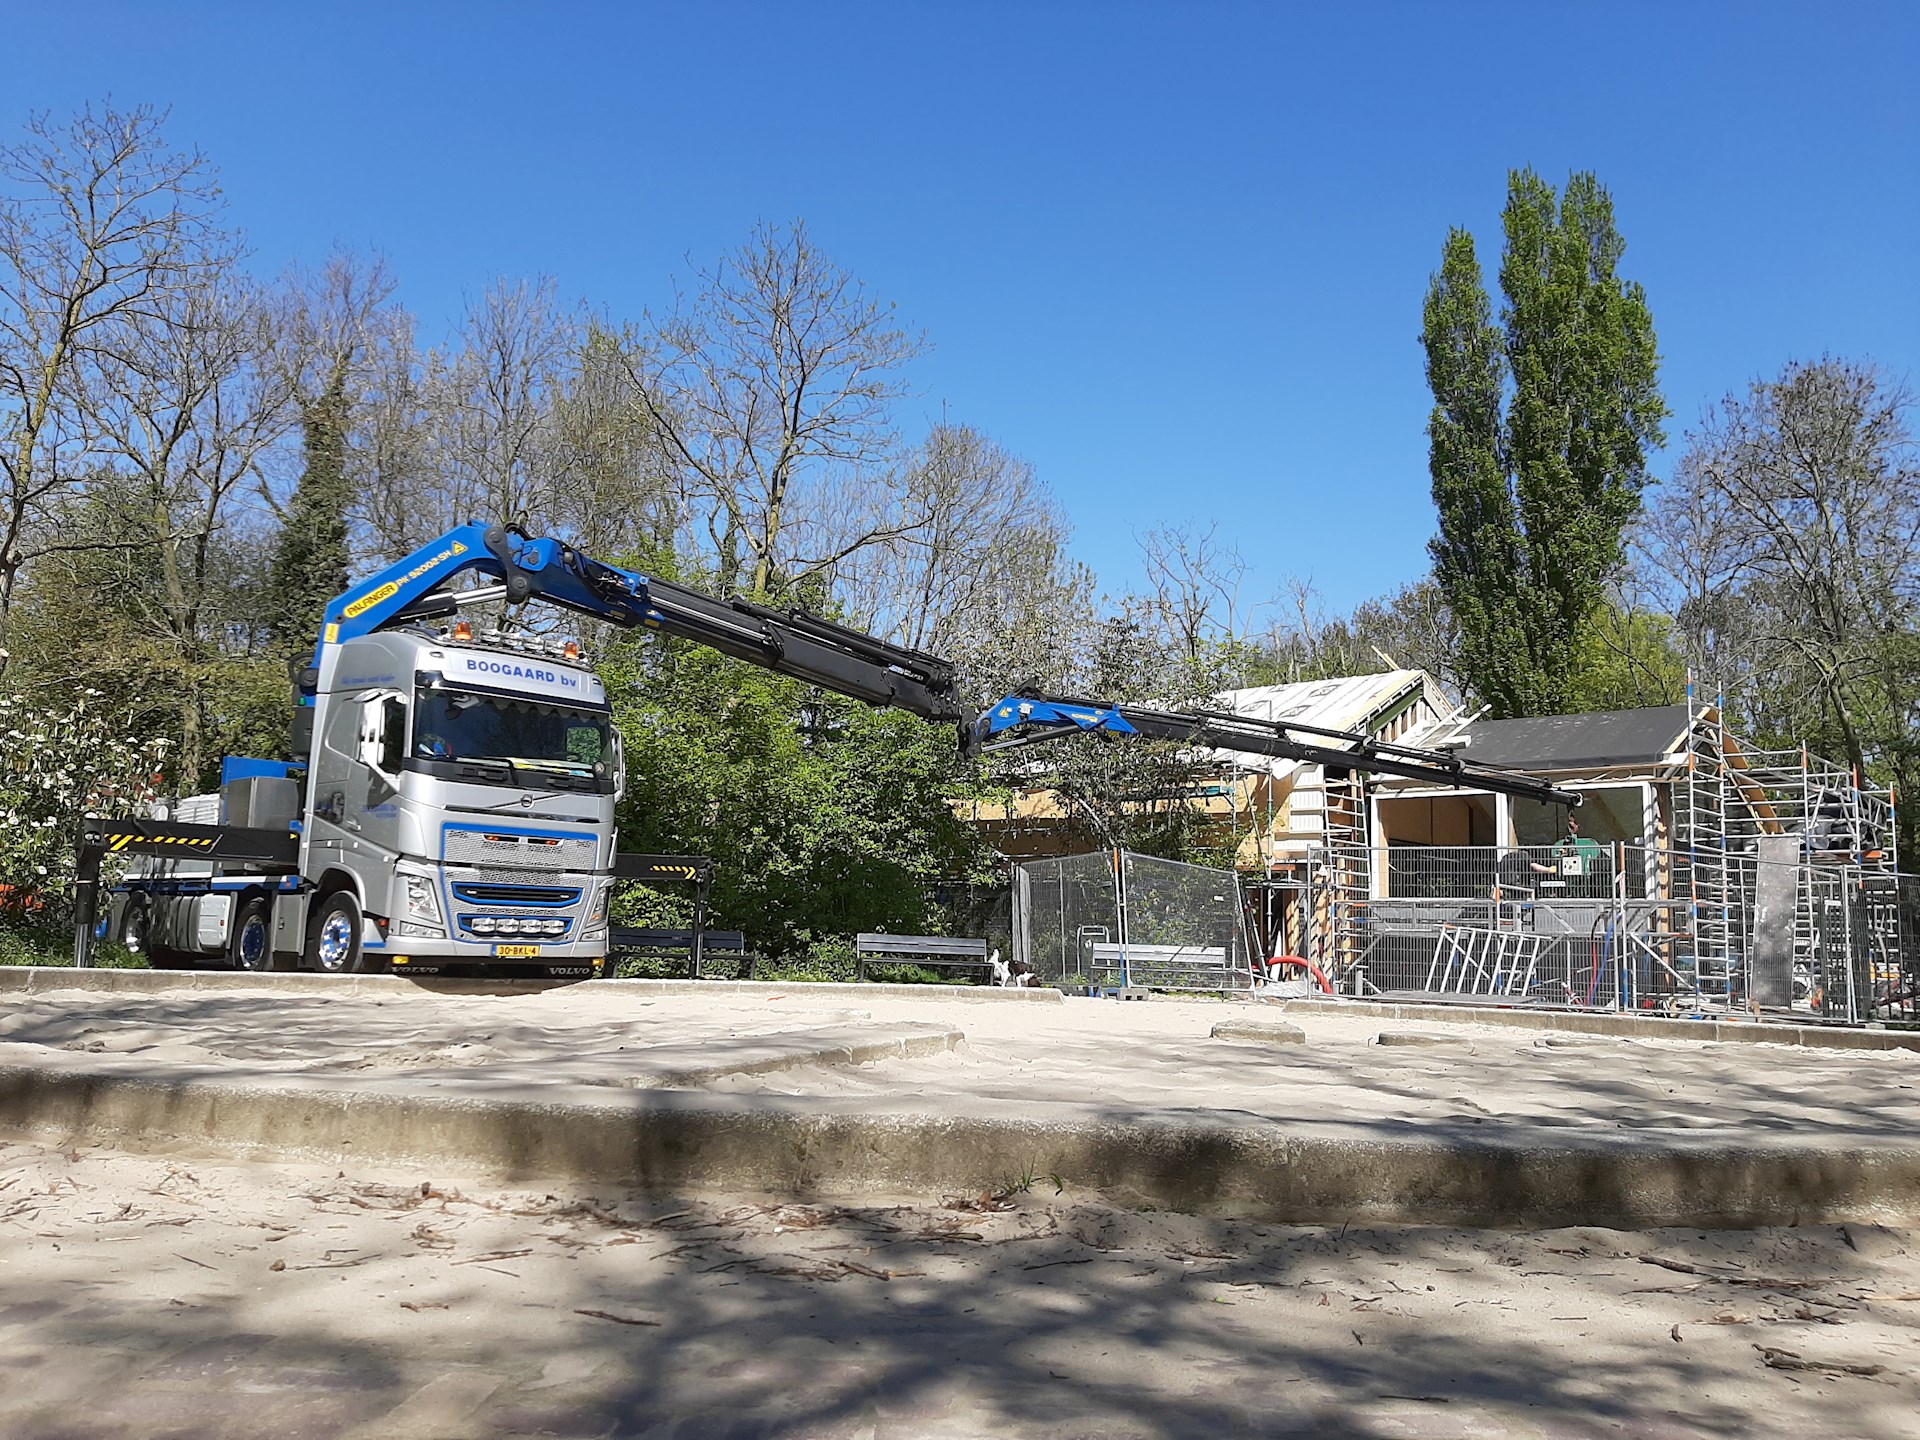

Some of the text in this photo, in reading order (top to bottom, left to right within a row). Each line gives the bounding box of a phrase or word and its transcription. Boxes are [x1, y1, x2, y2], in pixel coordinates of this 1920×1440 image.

[397, 575, 409, 587] PK
[467, 659, 576, 687] BOOGAARD bv
[391, 966, 439, 974] VOLVO
[549, 967, 590, 975] VOLVO
